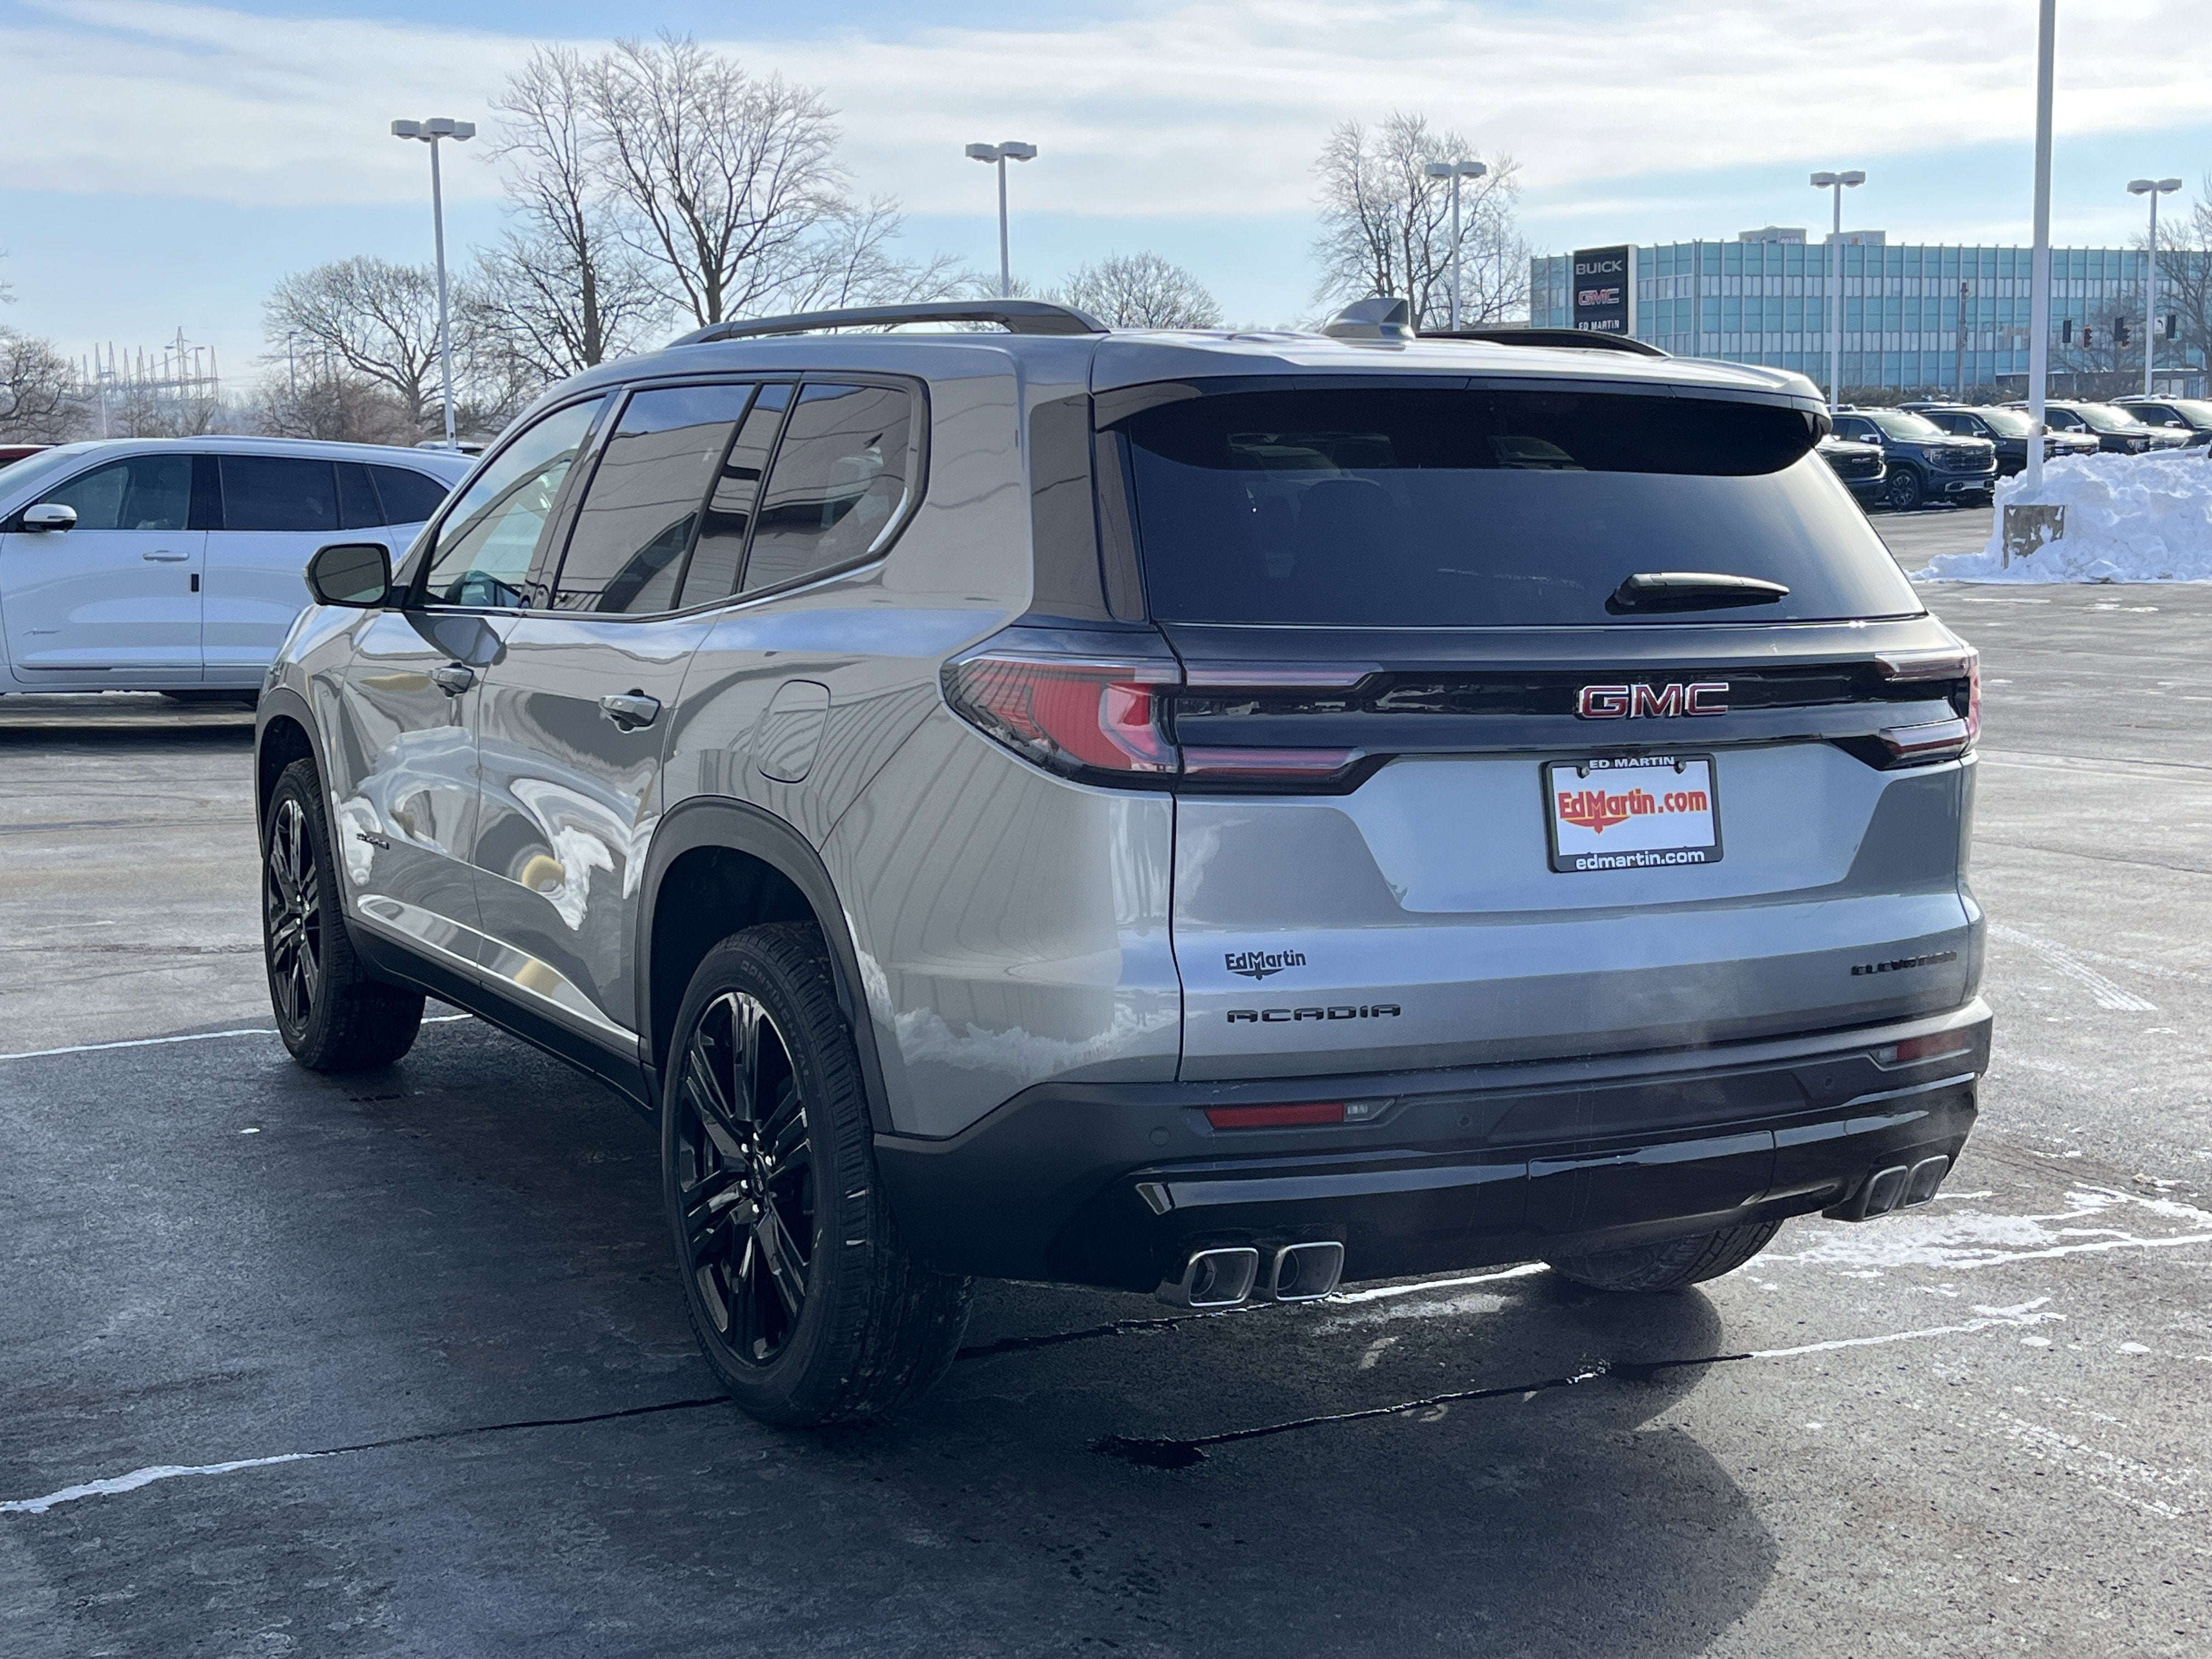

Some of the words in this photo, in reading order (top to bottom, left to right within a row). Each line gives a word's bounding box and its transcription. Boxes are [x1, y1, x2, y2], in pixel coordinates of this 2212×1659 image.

[1576, 260, 1623, 275] BUICK
[1578, 287, 1620, 306] GMC
[1578, 321, 1588, 330] ED
[1591, 320, 1620, 330] MARTIN
[1578, 682, 1729, 718] GMC
[1589, 759, 1610, 769] ED
[1615, 757, 1675, 768] MARTIN
[1558, 788, 1708, 820] EdMartin.com
[1575, 849, 1705, 870] edmartin.com
[1224, 950, 1306, 970] EdMartin
[1227, 1003, 1401, 1023] ACADIA
